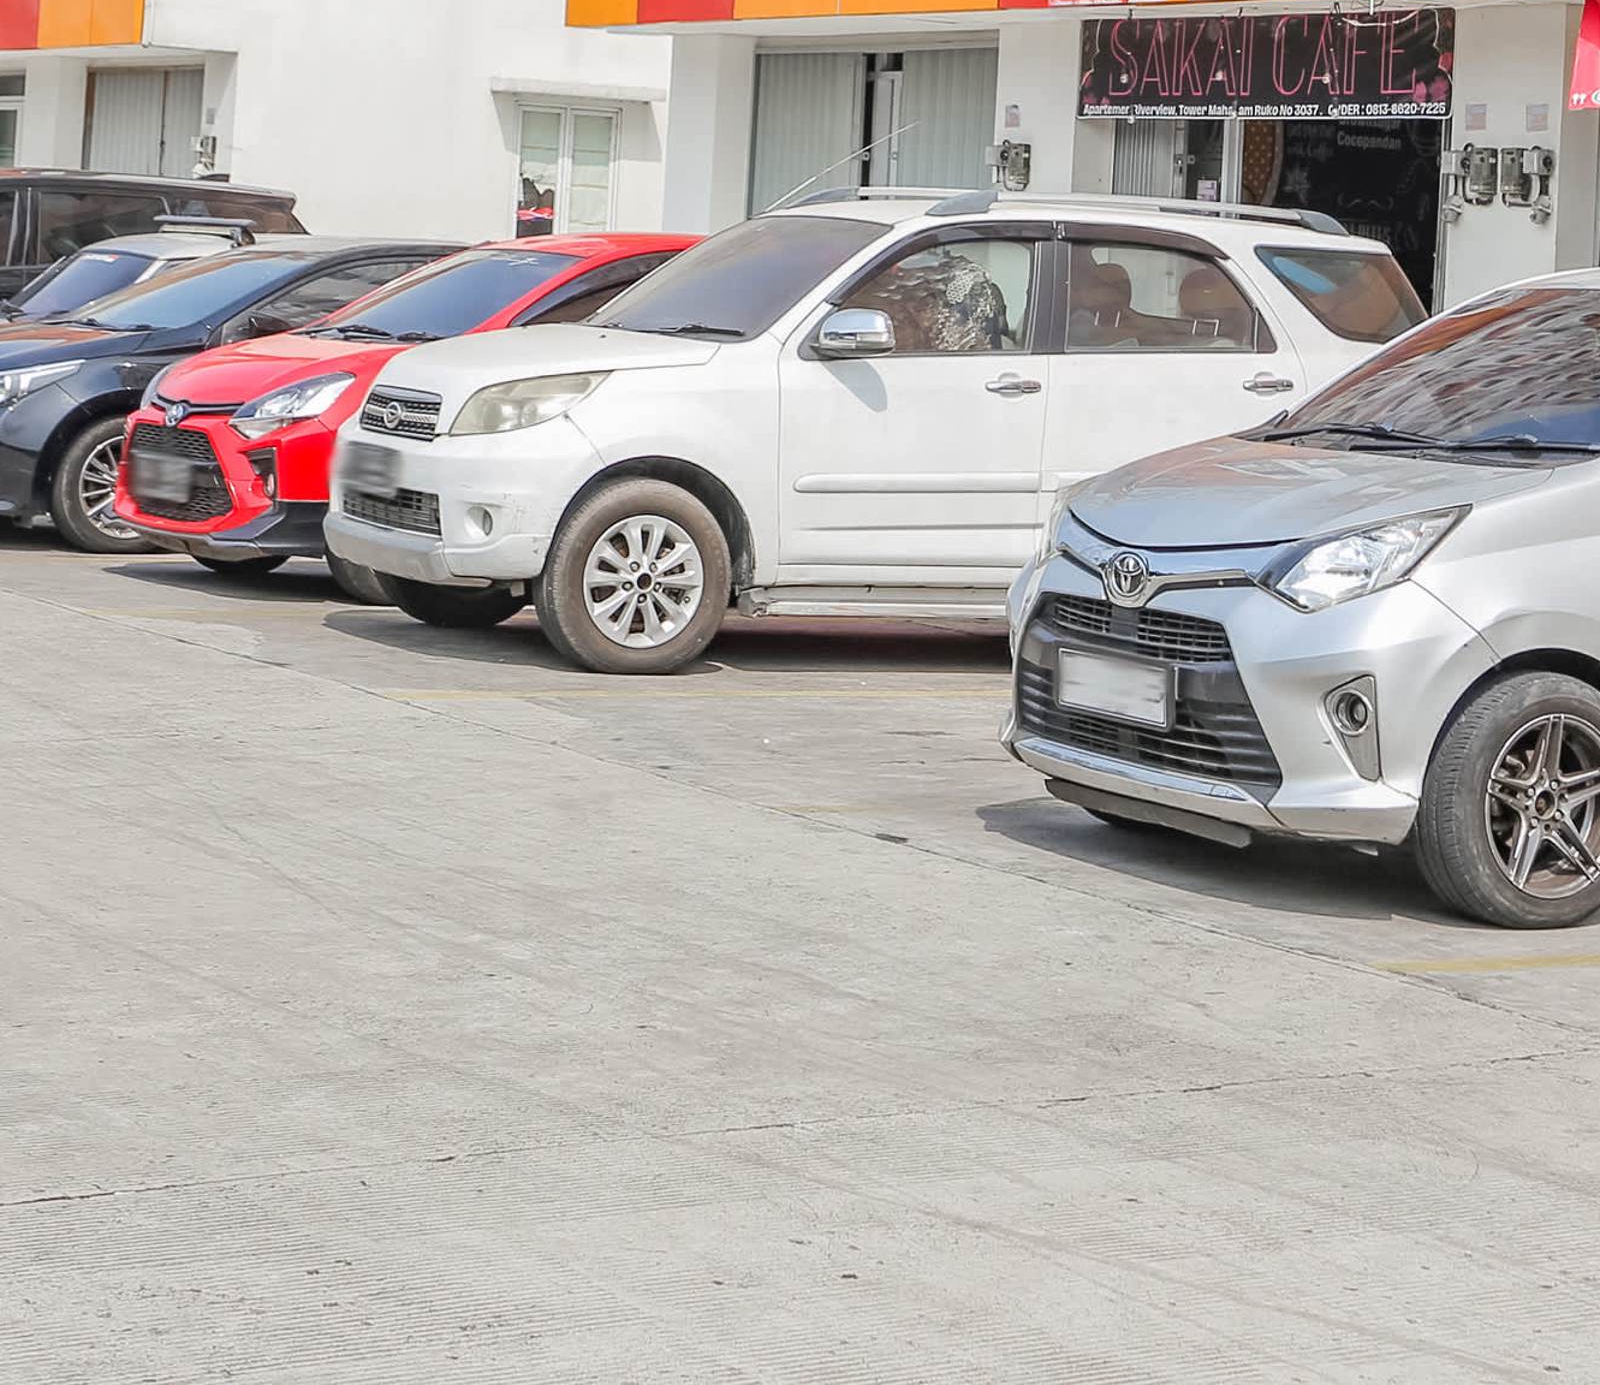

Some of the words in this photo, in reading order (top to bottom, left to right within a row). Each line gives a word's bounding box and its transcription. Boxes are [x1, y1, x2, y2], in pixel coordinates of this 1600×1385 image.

[1108, 17, 1255, 96] SAKAI
[1273, 11, 1418, 96] CAFE
[1179, 103, 1207, 115] Tower
[1208, 103, 1254, 115] Mahaam
[1254, 103, 1278, 116] Ruko
[1279, 103, 1293, 116] No
